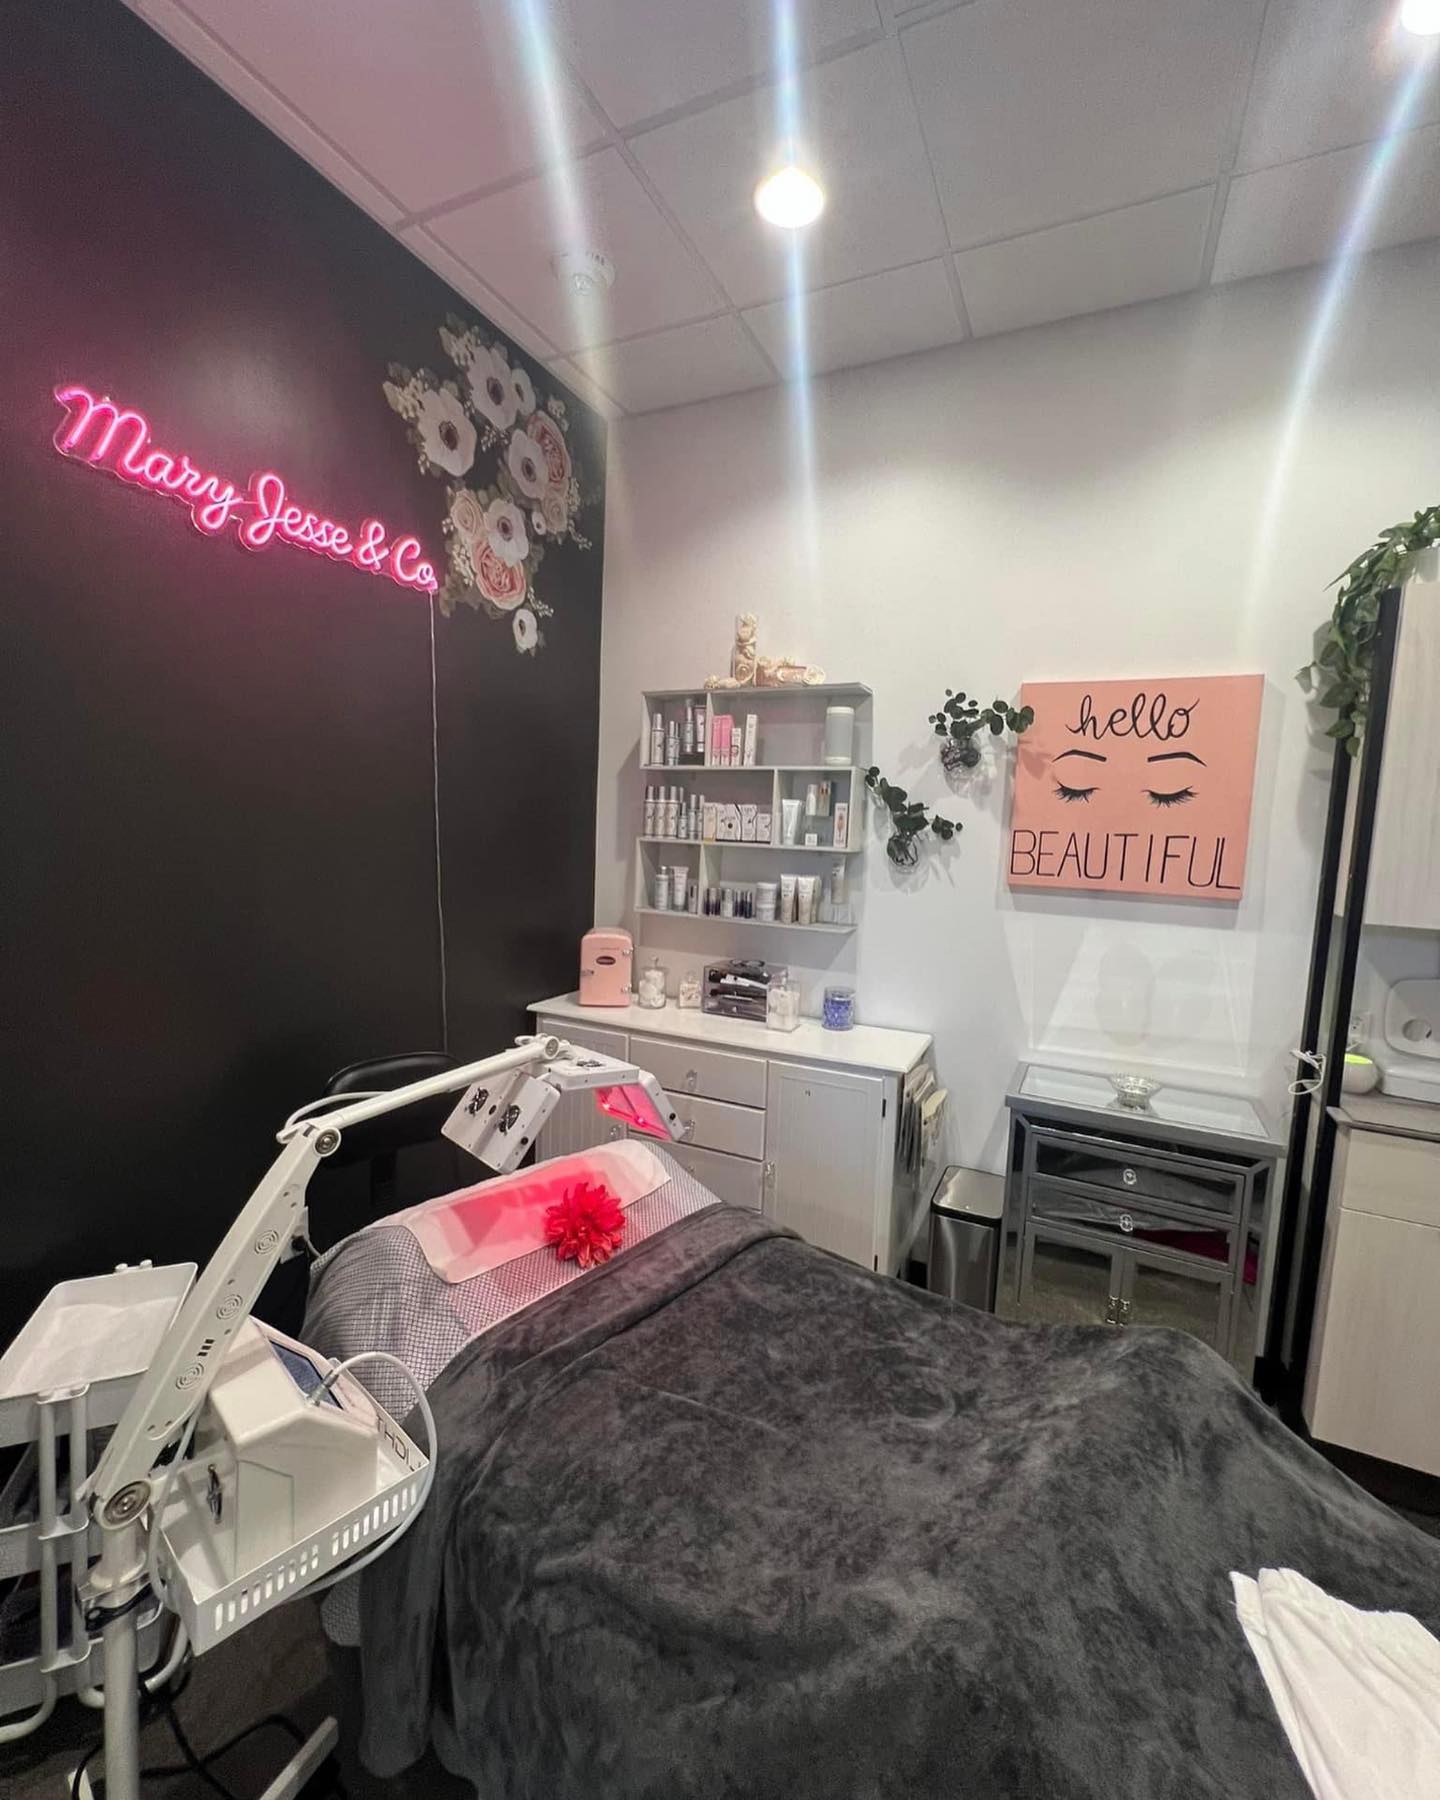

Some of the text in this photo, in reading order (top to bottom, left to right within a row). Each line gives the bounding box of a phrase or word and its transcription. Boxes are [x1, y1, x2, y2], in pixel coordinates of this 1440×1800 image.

[55, 387, 244, 530] Mary
[246, 473, 353, 555] Jesse
[358, 520, 390, 571] &
[1065, 692, 1201, 741] hello
[1009, 829, 1241, 890] BEAUTIFUL
